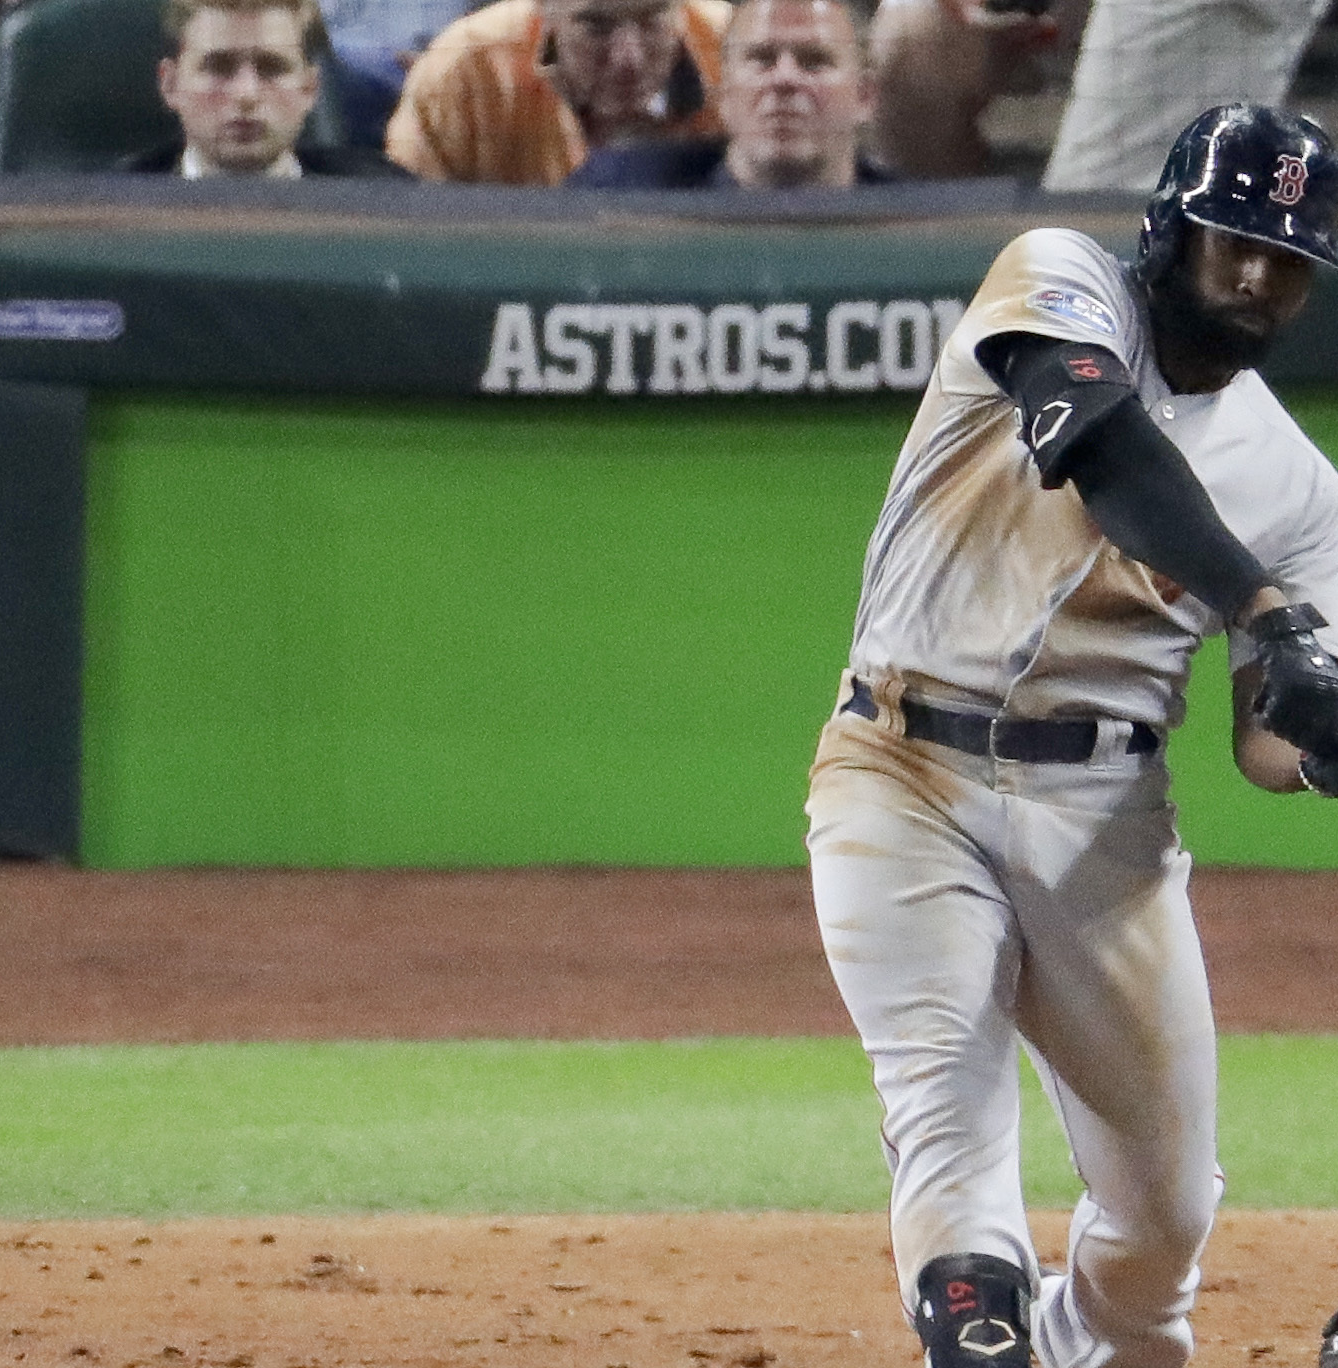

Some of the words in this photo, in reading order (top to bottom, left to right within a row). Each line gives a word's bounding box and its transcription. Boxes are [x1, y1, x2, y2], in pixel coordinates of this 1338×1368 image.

[1268, 153, 1310, 206] B
[481, 299, 966, 393] ASTROS.CO
[946, 1280, 977, 1315] 19
